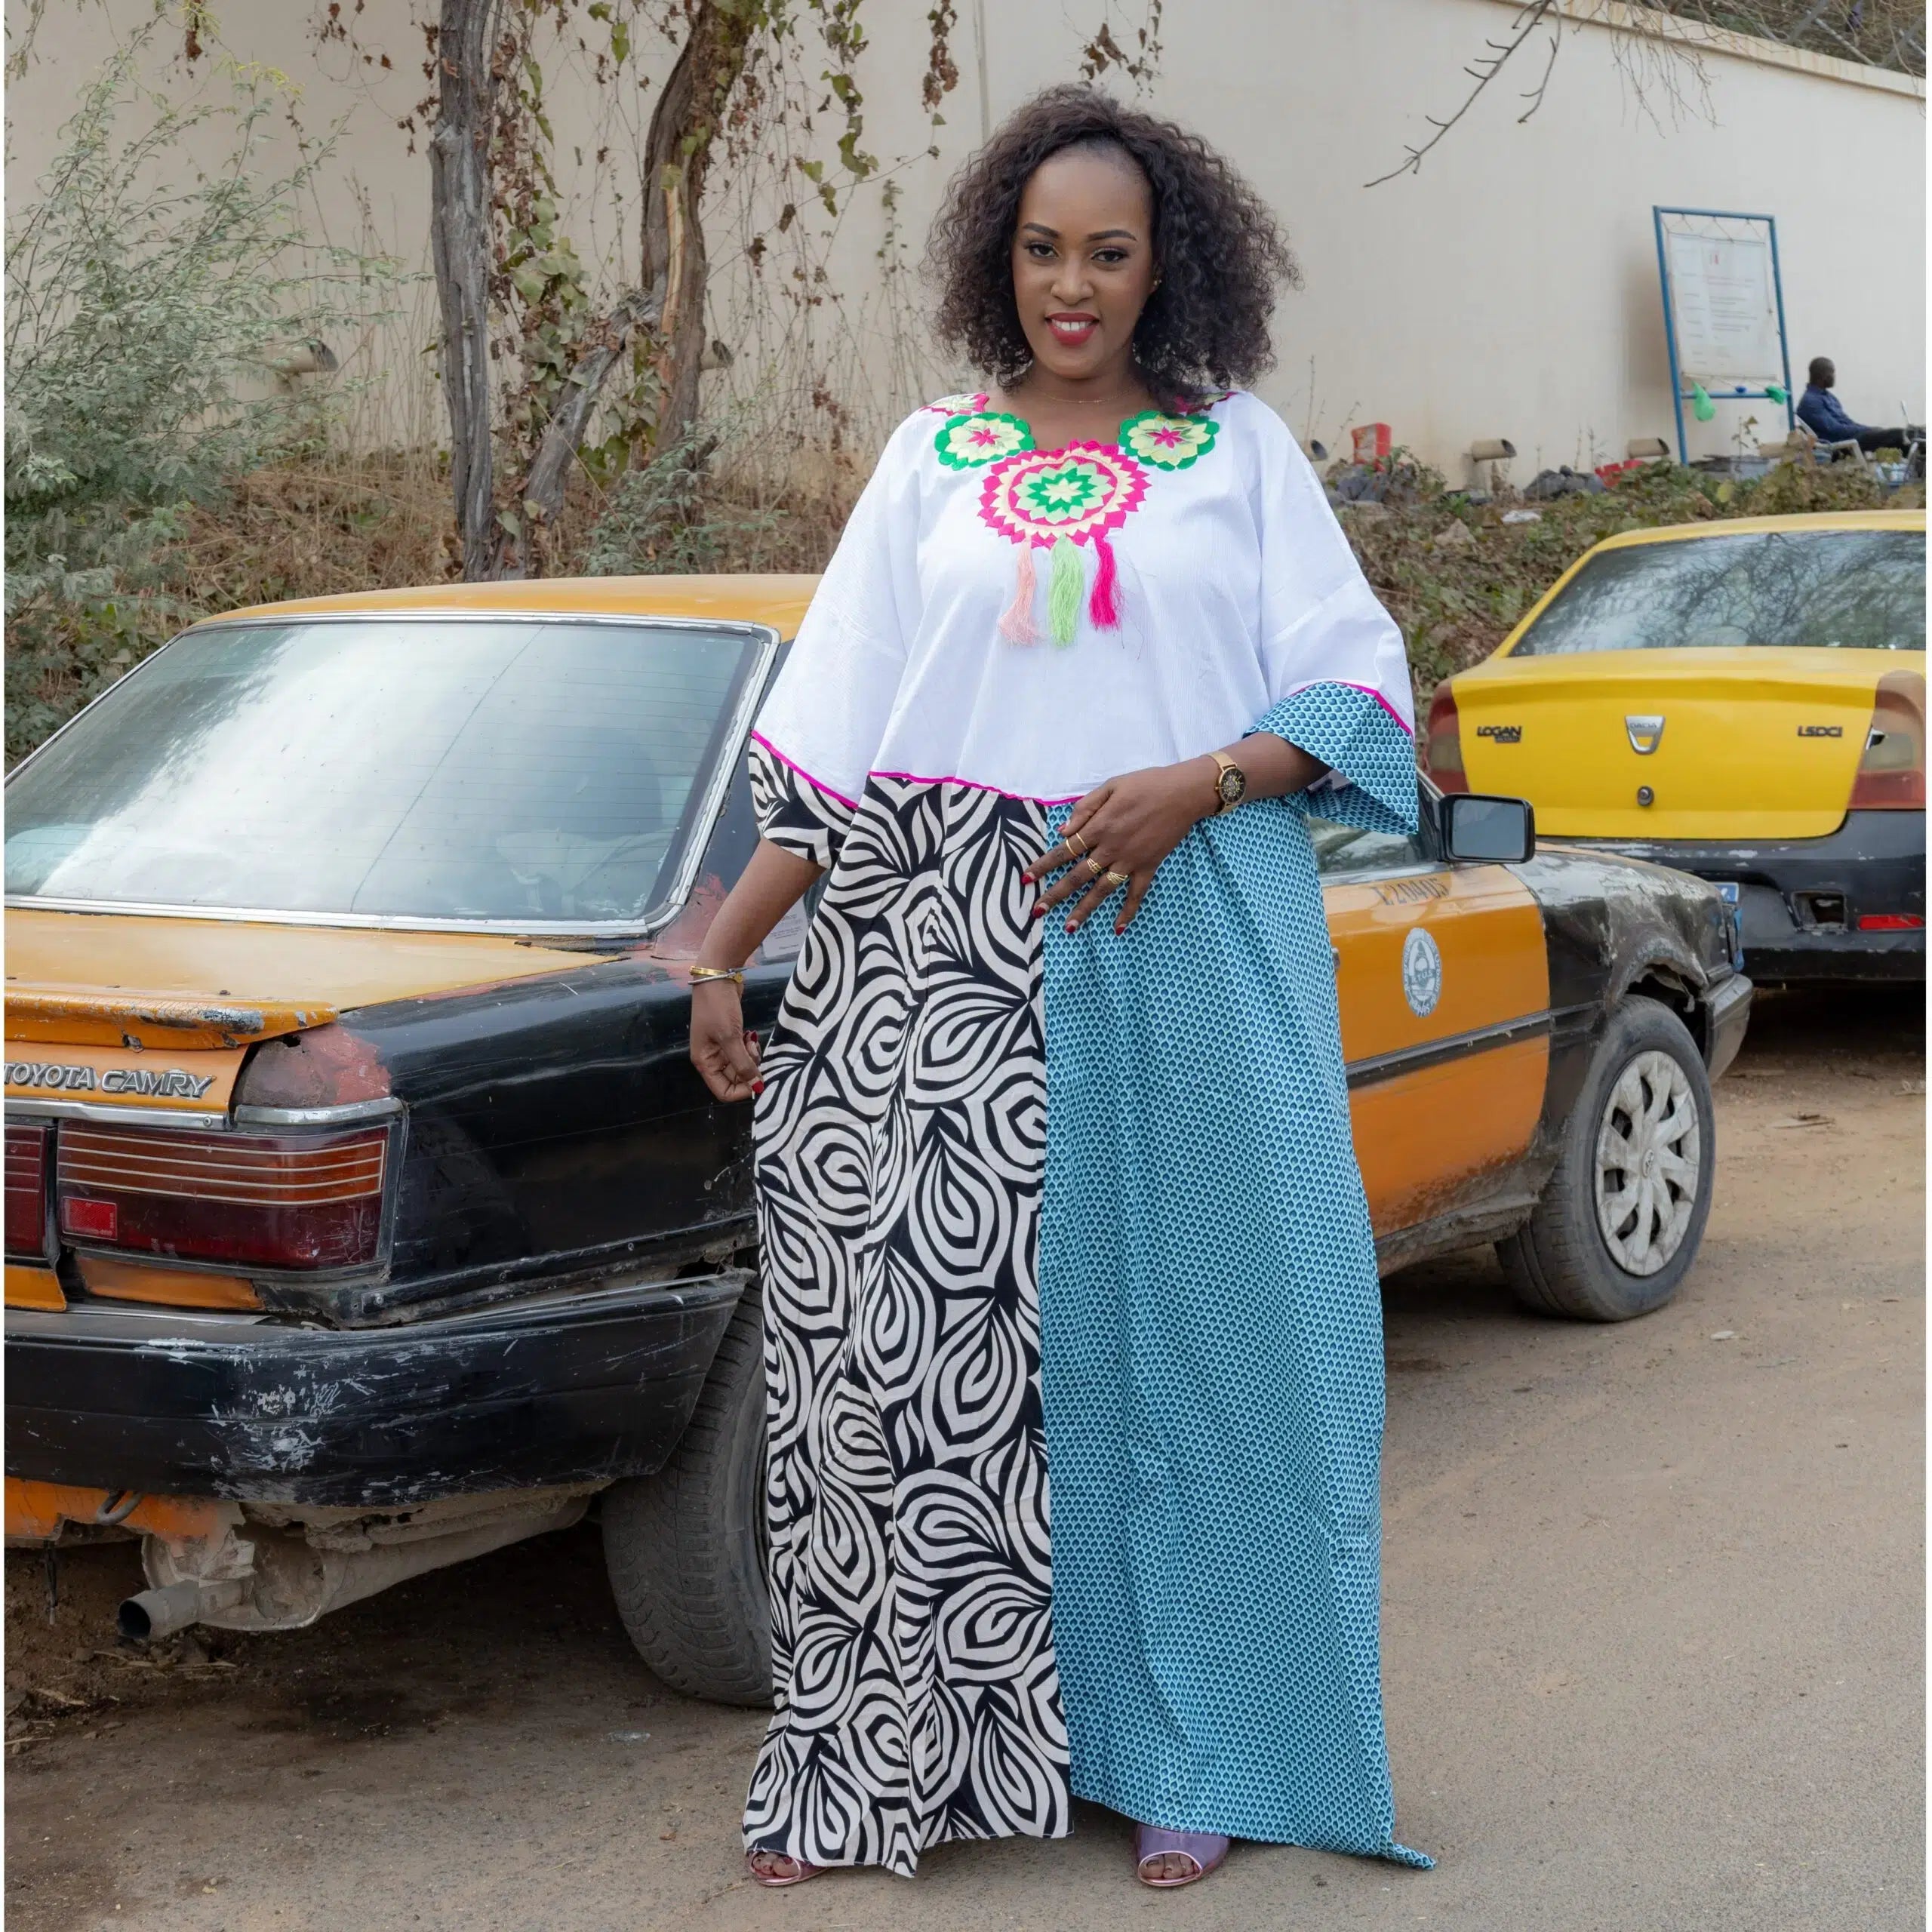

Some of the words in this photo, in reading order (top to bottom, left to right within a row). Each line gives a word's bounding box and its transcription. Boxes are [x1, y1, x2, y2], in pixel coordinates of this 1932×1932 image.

[1477, 726, 1521, 737] LOGAN
[4, 1063, 95, 1090] TOYOTA
[101, 1069, 214, 1099] CAMRY
